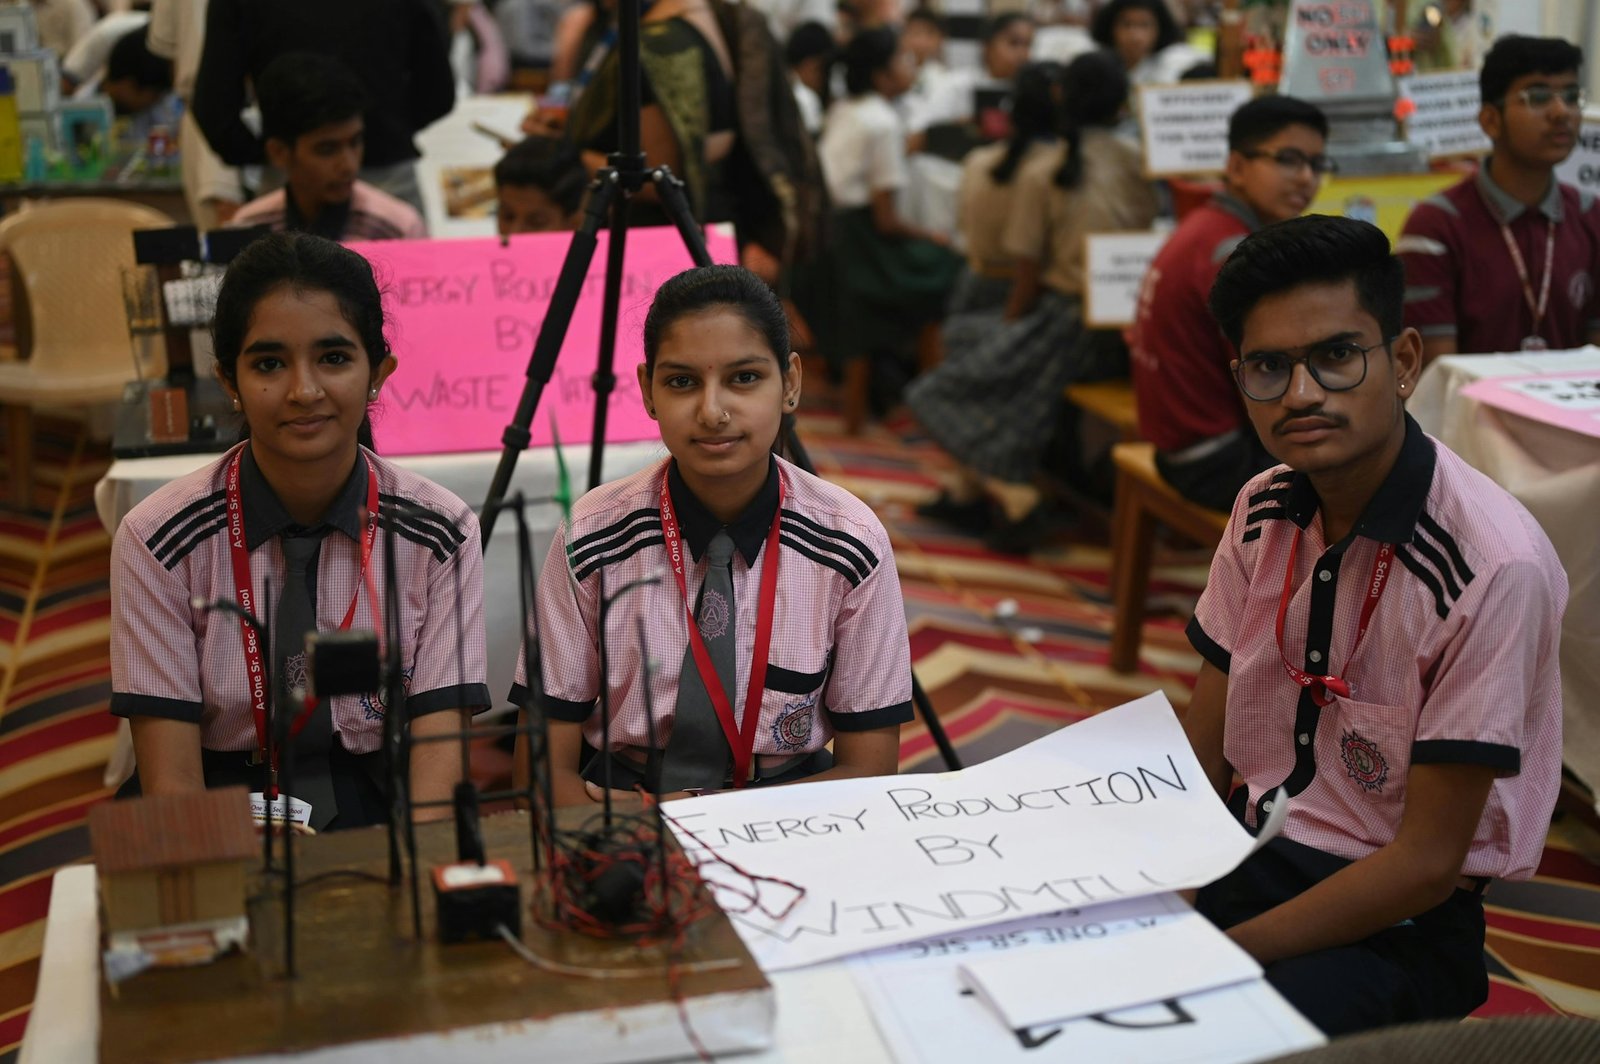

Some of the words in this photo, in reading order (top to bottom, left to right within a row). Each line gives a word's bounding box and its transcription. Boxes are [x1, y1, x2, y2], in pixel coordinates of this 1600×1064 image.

[389, 370, 510, 412] WASTE
[228, 468, 237, 491] Sec.
[229, 494, 239, 511] Sr.
[663, 497, 672, 520] Sec.
[231, 512, 243, 549] A-One
[667, 522, 677, 538] Sr.
[671, 541, 682, 574] A-One
[1371, 561, 1388, 598] School
[248, 629, 257, 654] Sec.
[251, 656, 260, 672] Sr.
[254, 675, 266, 710] A-One
[666, 808, 868, 850] ENERGY
[887, 755, 1187, 821] PRODUCTION
[916, 834, 1003, 866] BY
[1047, 922, 1107, 944] ONE
